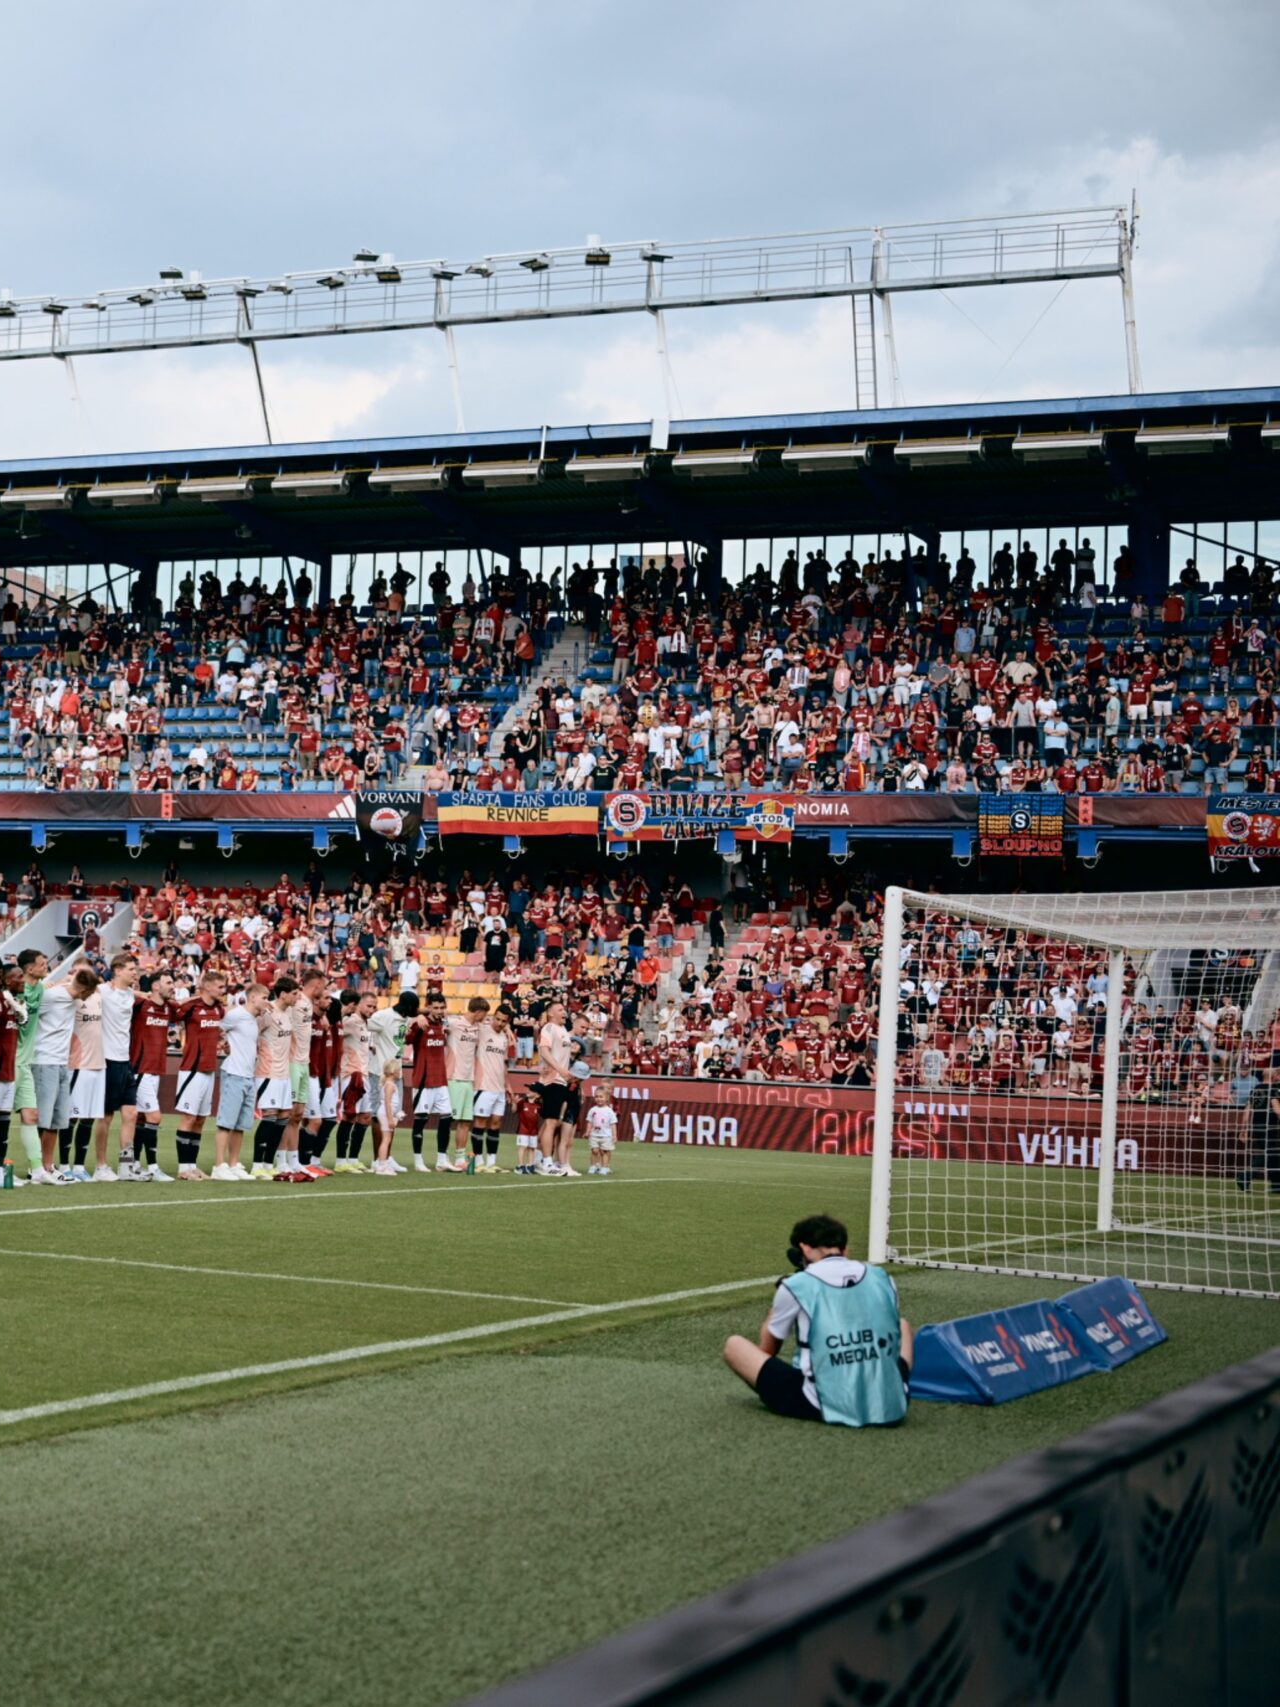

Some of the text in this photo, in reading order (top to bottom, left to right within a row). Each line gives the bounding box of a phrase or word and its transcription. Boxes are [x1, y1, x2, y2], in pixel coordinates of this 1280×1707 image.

[451, 792, 588, 807] SPARTA FANS CLUB
[648, 793, 747, 819] DIVIZE
[620, 802, 636, 823] S
[795, 803, 850, 816] NOMIA
[753, 814, 784, 824] STOD
[1014, 813, 1026, 828] S
[981, 839, 1062, 851] SLOUPNO
[631, 1106, 738, 1147] VÝHRA
[825, 1329, 874, 1350] CLUB
[829, 1348, 879, 1368] MEDIA
